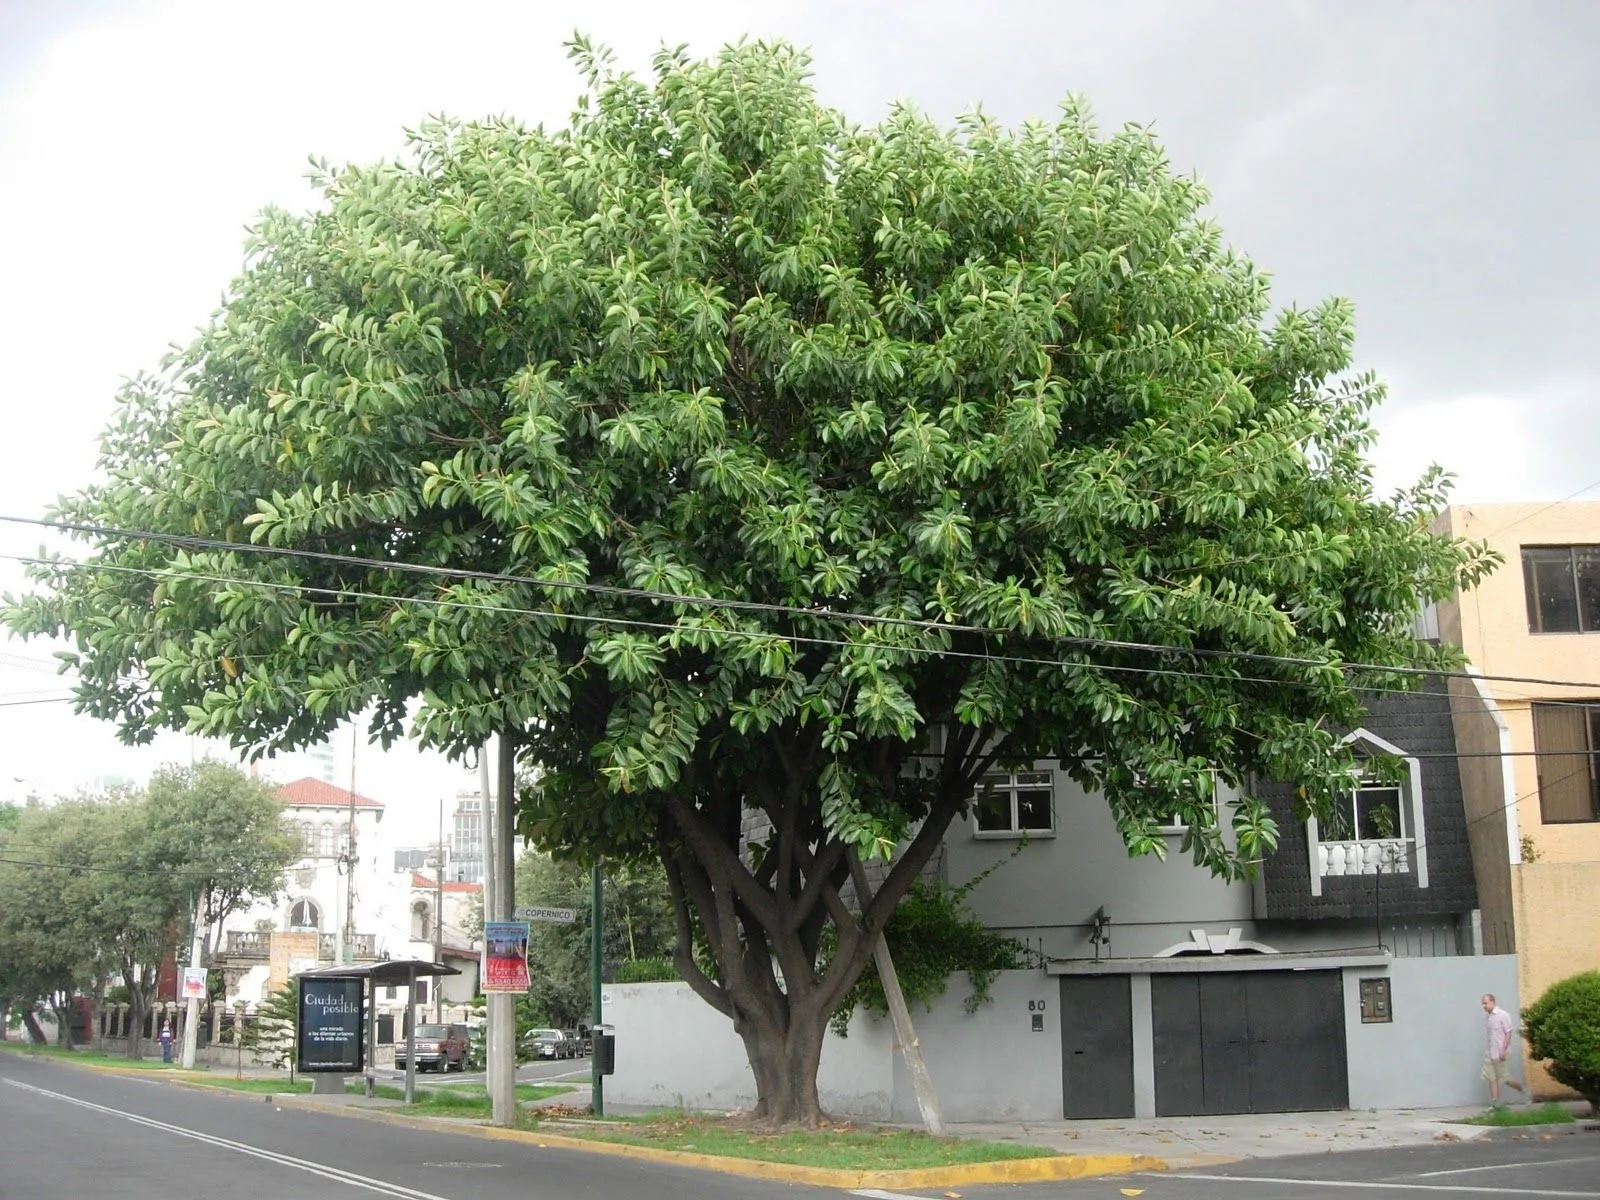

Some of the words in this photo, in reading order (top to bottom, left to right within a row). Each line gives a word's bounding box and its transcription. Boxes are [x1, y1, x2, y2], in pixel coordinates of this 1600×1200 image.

[525, 908, 570, 919] COPERNICO
[305, 993, 344, 1005] Ciudad
[322, 1002, 359, 1015] posible
